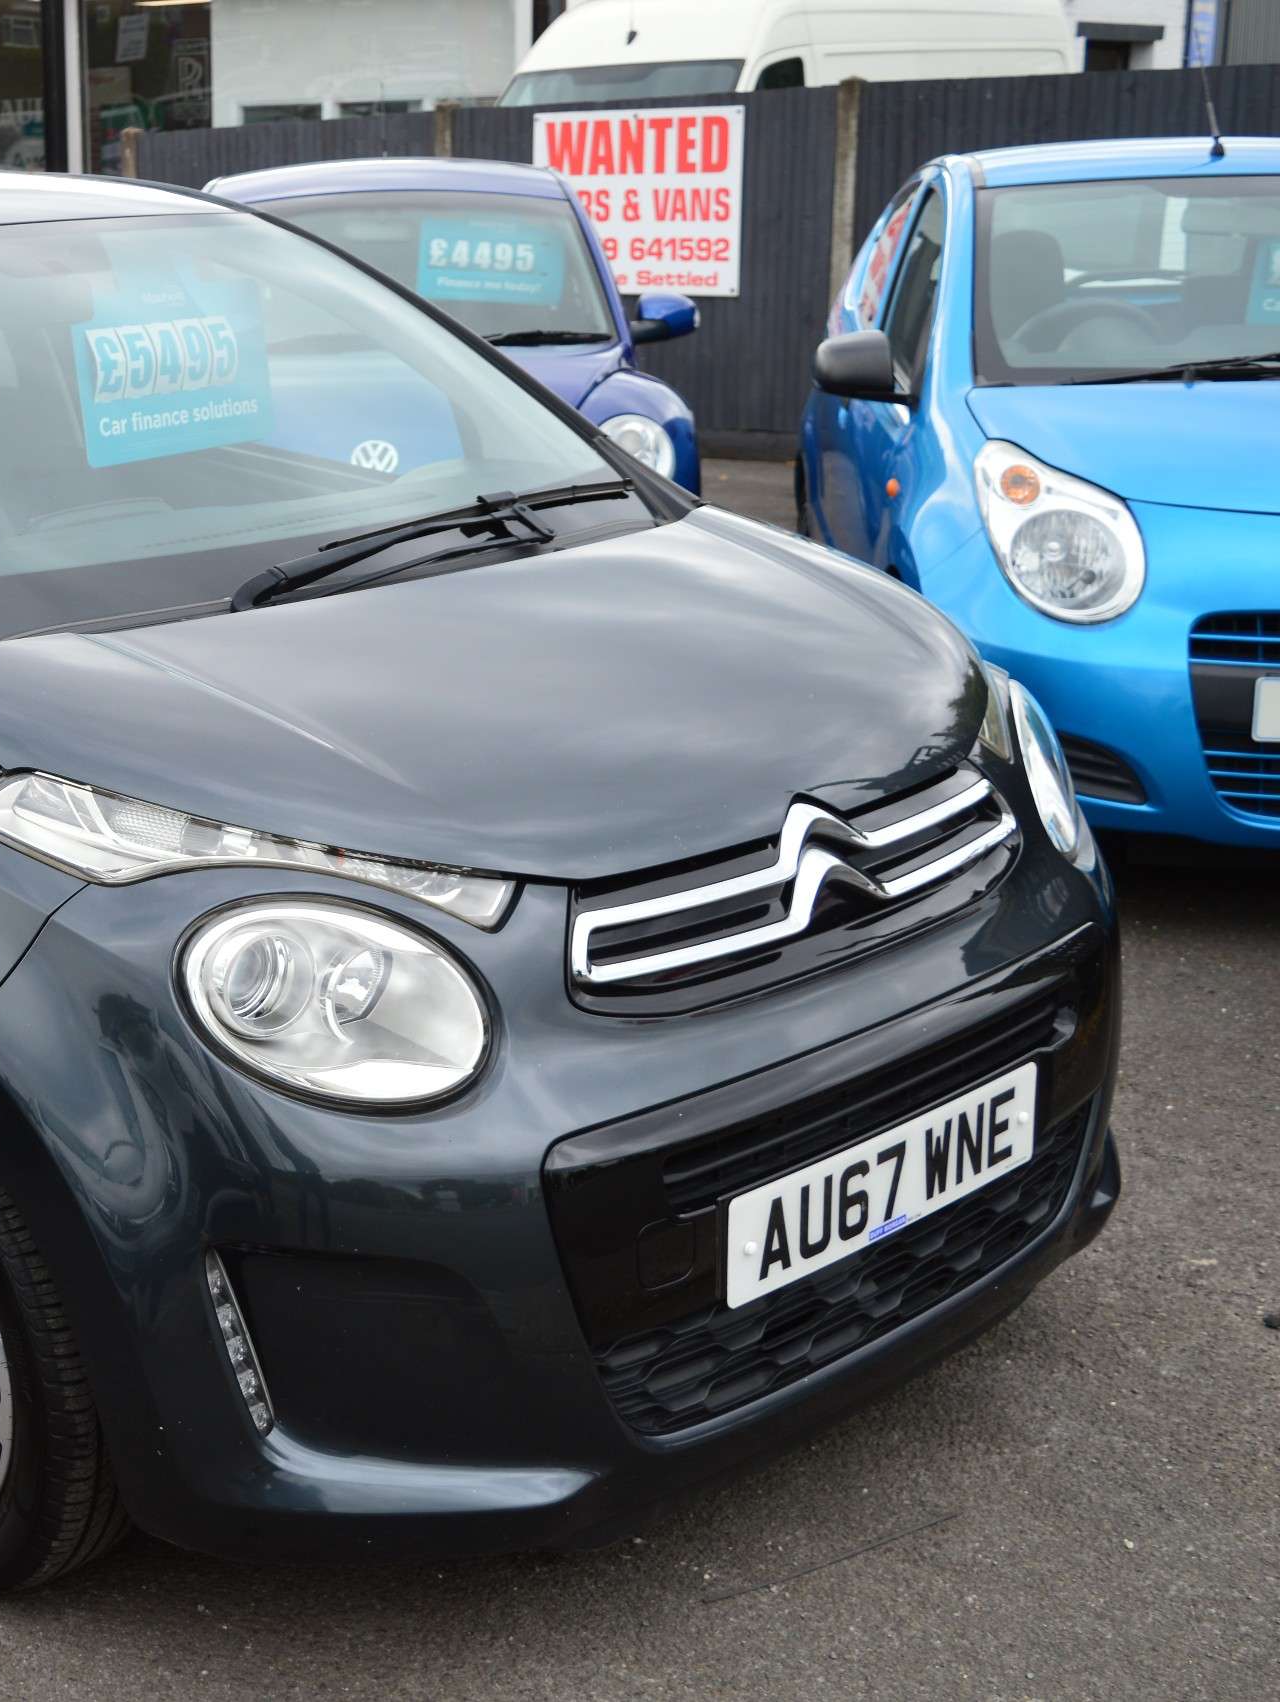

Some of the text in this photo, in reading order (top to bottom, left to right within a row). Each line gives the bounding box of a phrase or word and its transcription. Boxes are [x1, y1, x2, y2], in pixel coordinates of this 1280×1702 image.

[545, 115, 729, 176] WANTED
[577, 188, 730, 222] RS & VANS
[429, 238, 536, 272] £4495
[631, 237, 730, 261] 641592
[636, 271, 718, 287] Settled
[88, 316, 238, 402] £5495
[99, 399, 258, 437] Car finance solutions
[758, 1086, 1016, 1281] AU67 WNE
